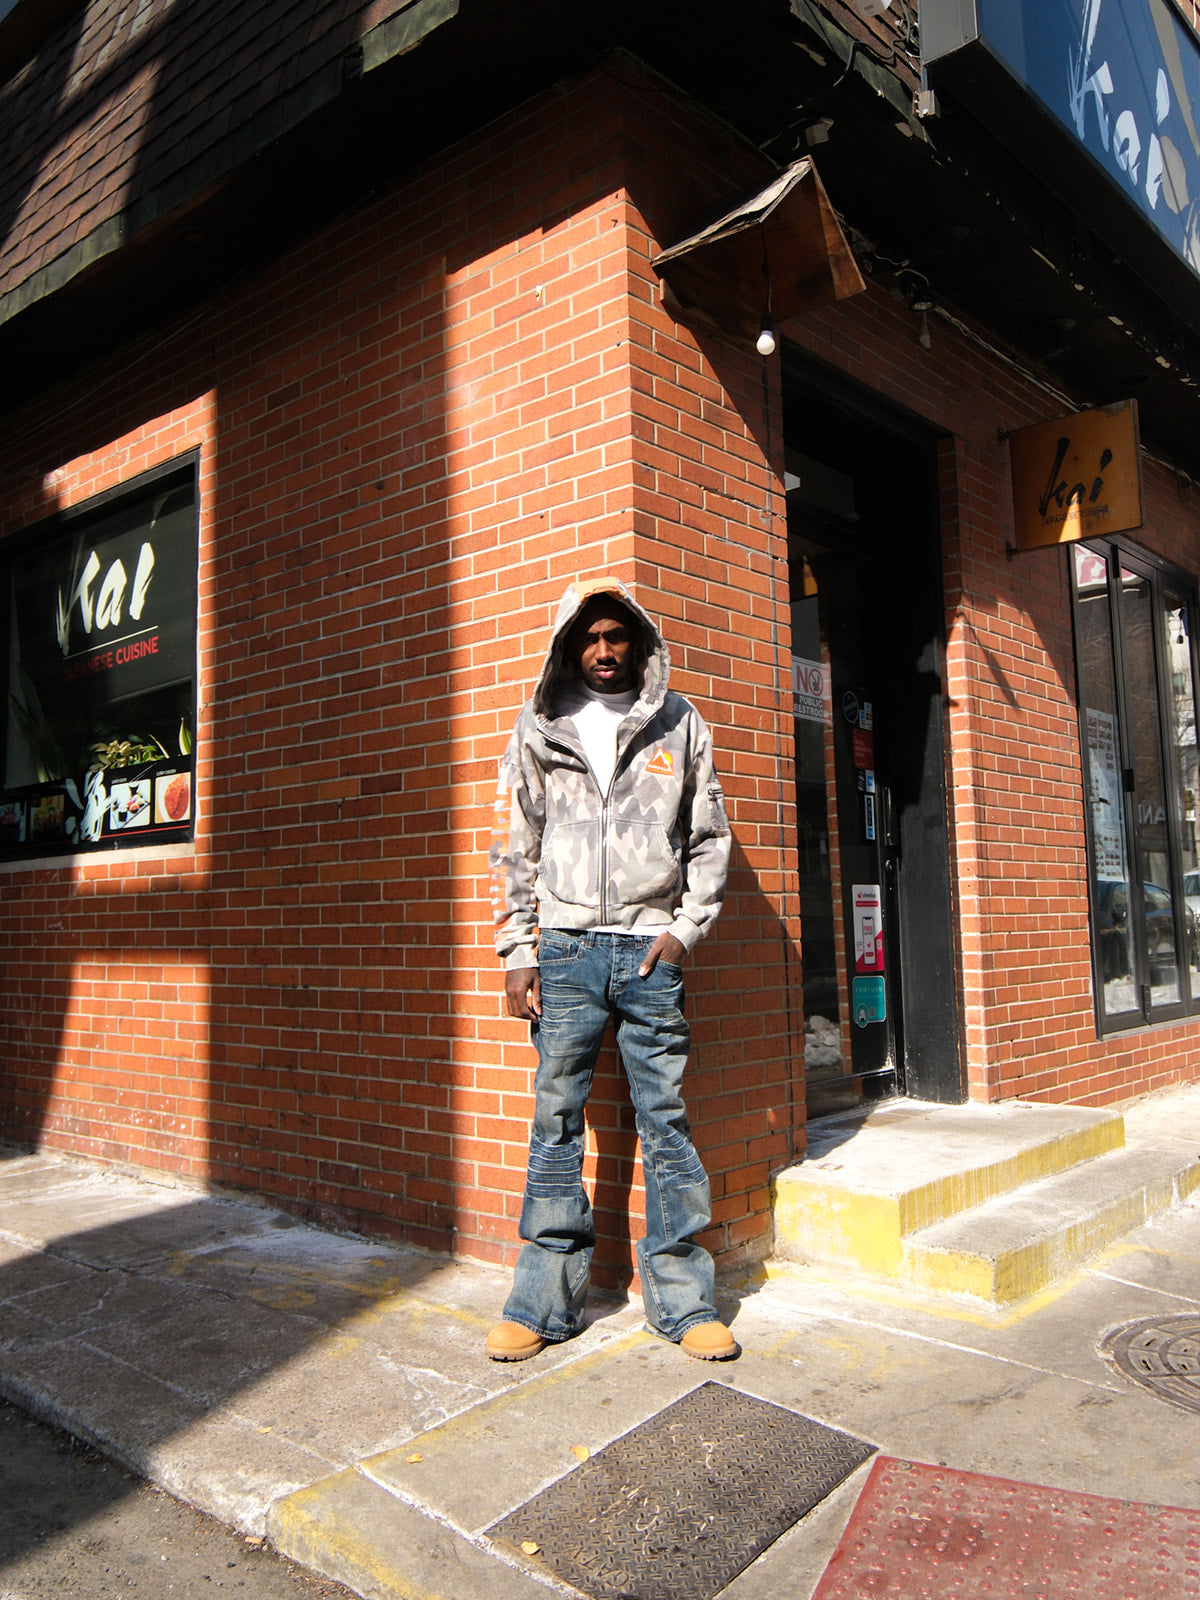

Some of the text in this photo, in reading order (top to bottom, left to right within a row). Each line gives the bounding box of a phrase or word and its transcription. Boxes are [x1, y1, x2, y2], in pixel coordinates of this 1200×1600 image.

[64, 636, 159, 682] JAPANESE CUISINE
[799, 695, 823, 708] PUBLIC
